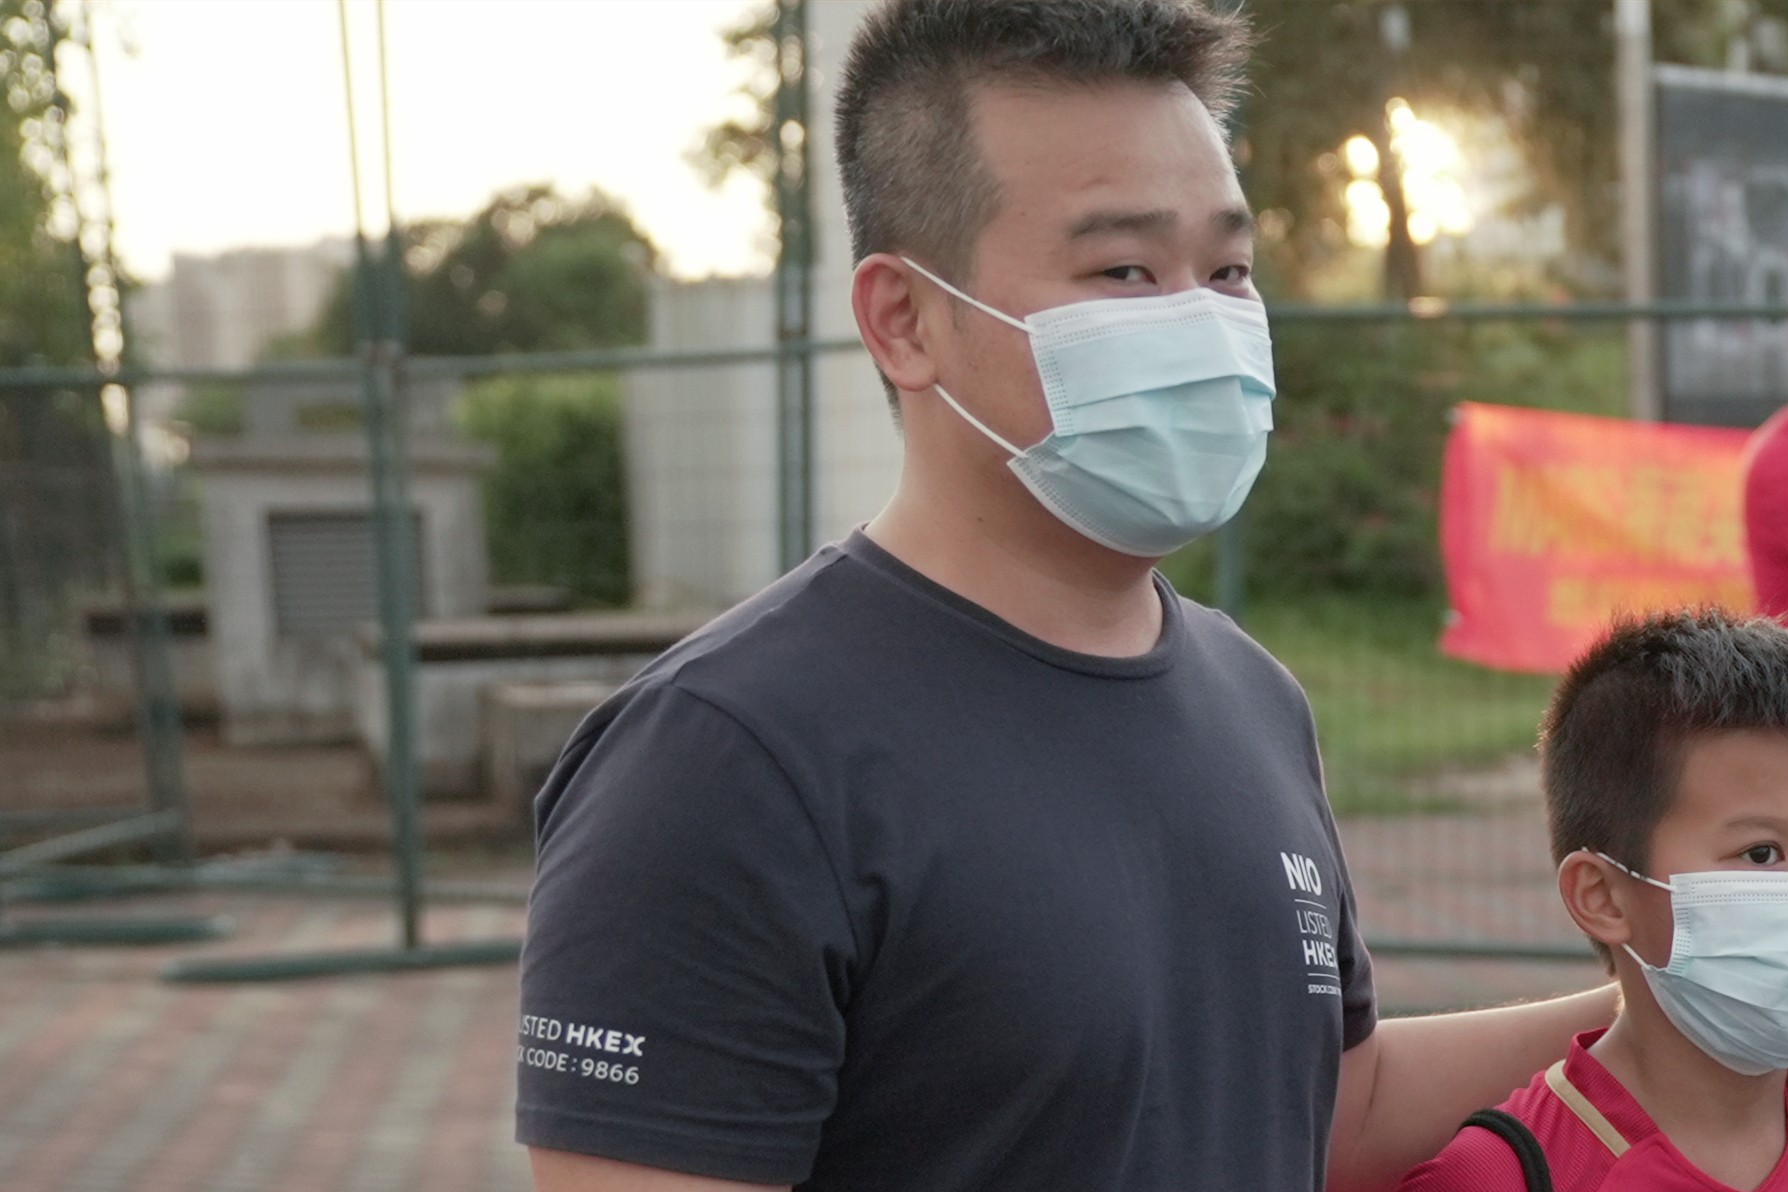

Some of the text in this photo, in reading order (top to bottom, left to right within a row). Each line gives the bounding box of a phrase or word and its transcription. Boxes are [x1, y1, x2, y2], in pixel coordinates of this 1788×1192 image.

[1280, 851, 1322, 896] NIO
[566, 1023, 646, 1057] HKEX
[581, 1058, 640, 1085] 9866
